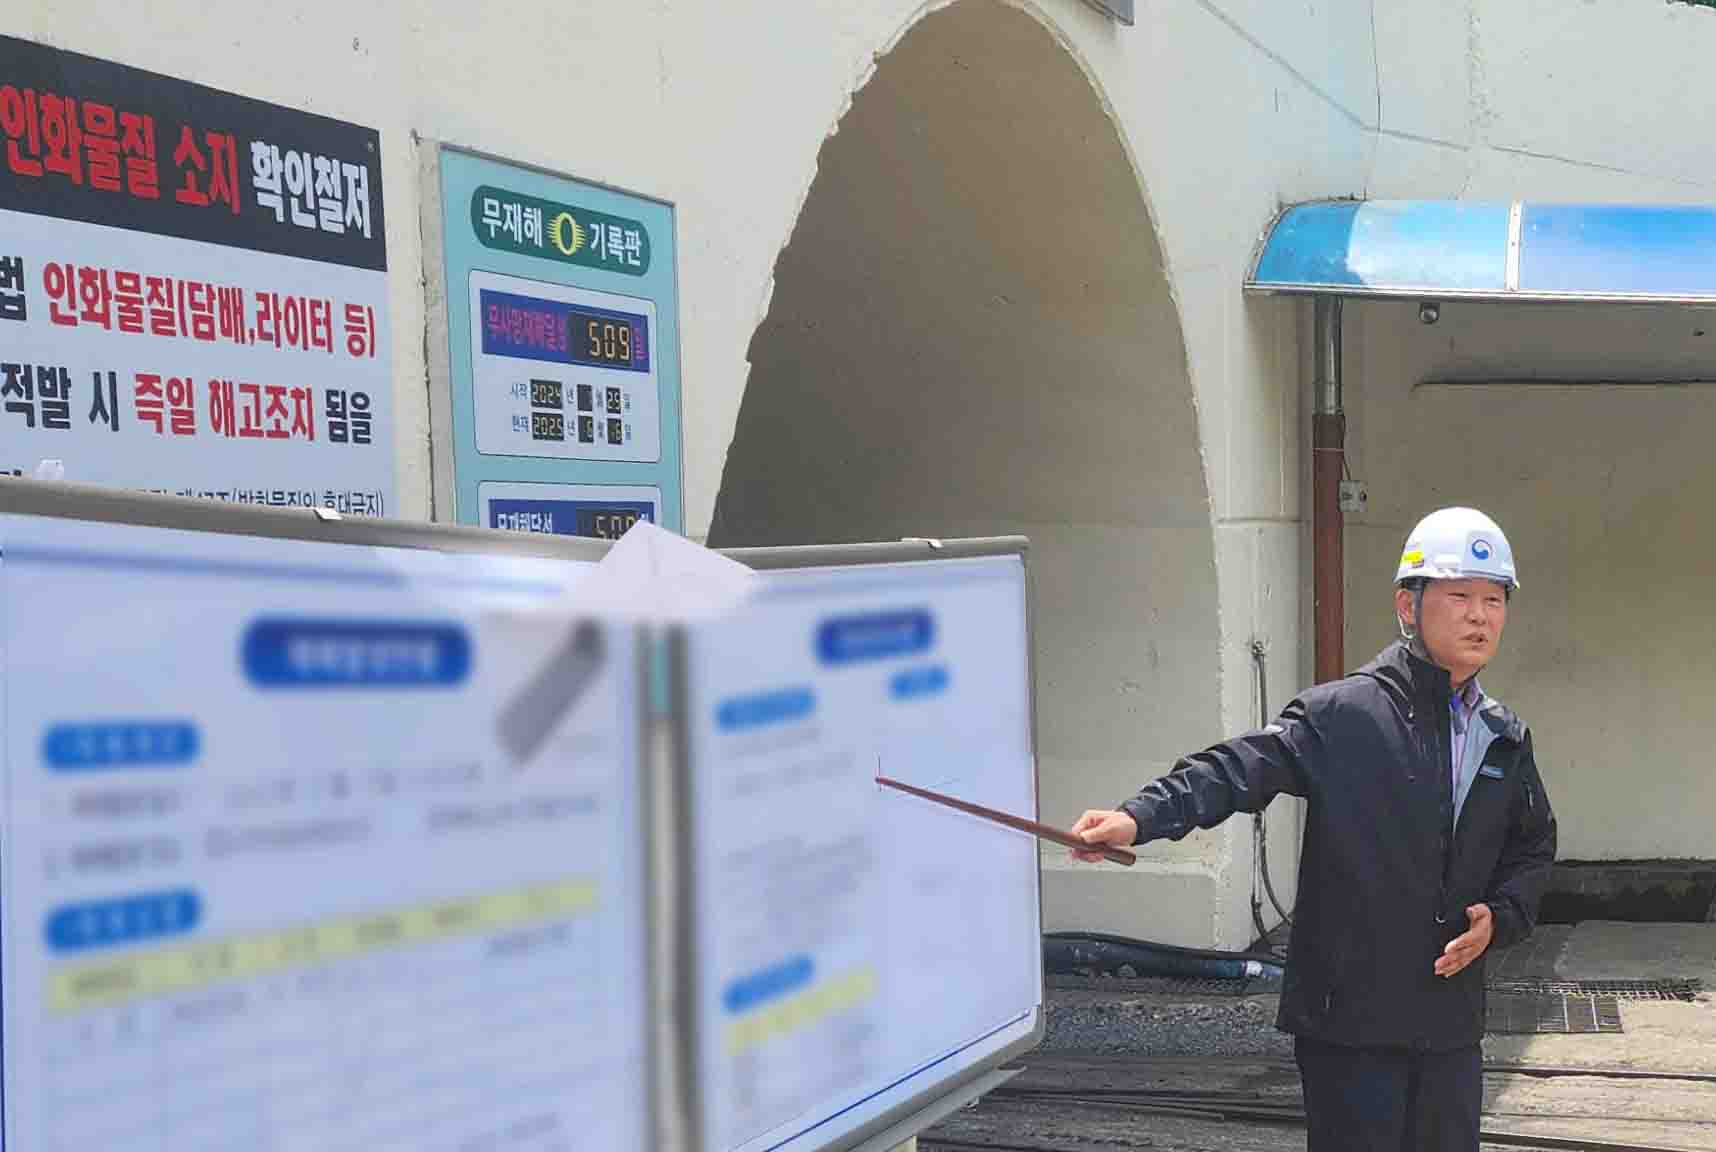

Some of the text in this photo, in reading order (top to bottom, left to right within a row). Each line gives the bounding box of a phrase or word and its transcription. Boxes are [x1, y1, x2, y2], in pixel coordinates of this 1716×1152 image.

[0, 84, 372, 239] 인화물질 소지 확인철저
[482, 197, 544, 248] 무재해
[589, 223, 641, 266] 기록판
[43, 262, 334, 354] 인화물질(담배,라이터
[344, 302, 375, 358] 등)
[588, 320, 631, 361] 509
[0, 362, 373, 445] 적발 시 즉일 해고조치 됨을
